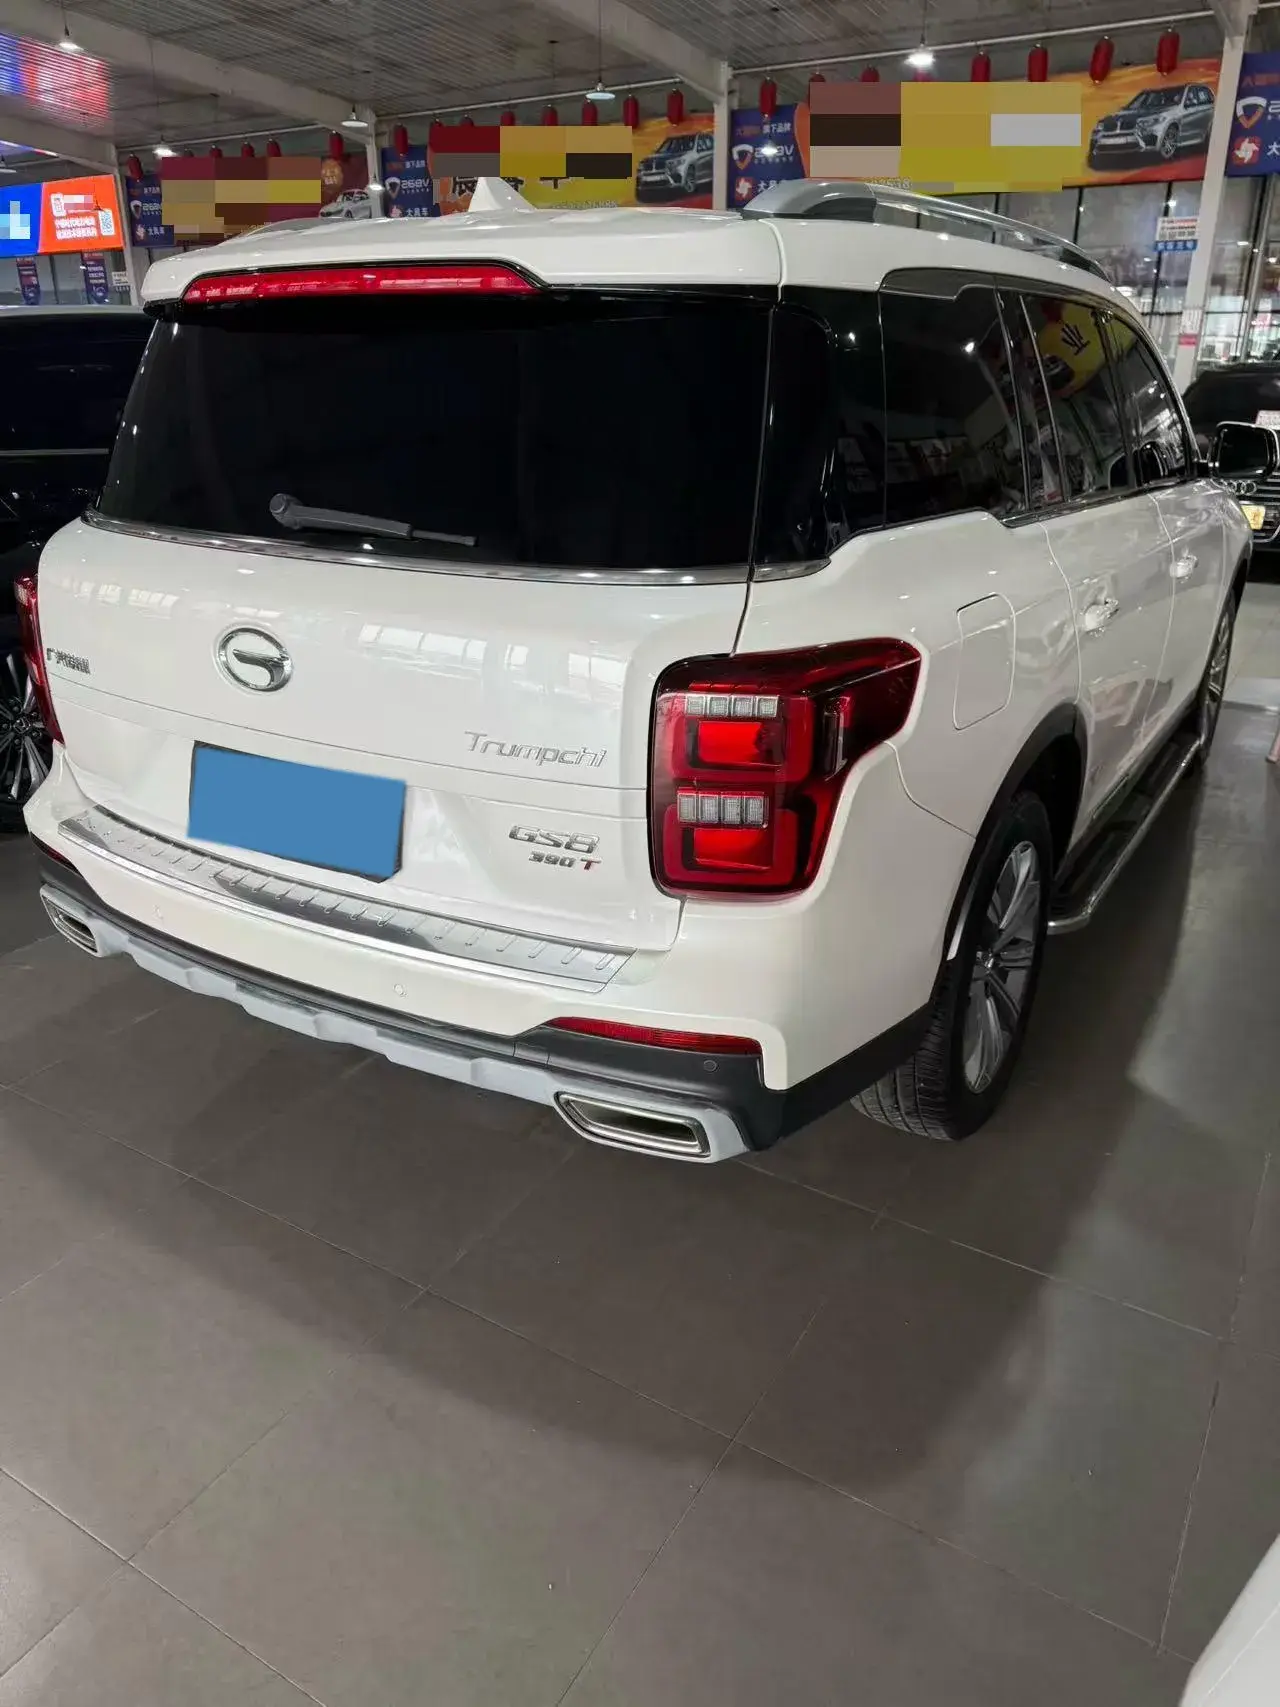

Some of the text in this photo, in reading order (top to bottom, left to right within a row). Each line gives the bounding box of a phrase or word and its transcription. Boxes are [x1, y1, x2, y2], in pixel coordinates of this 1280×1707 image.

[464, 730, 608, 768] Trumpchi
[508, 825, 601, 854] GS8
[528, 851, 577, 869] 390
